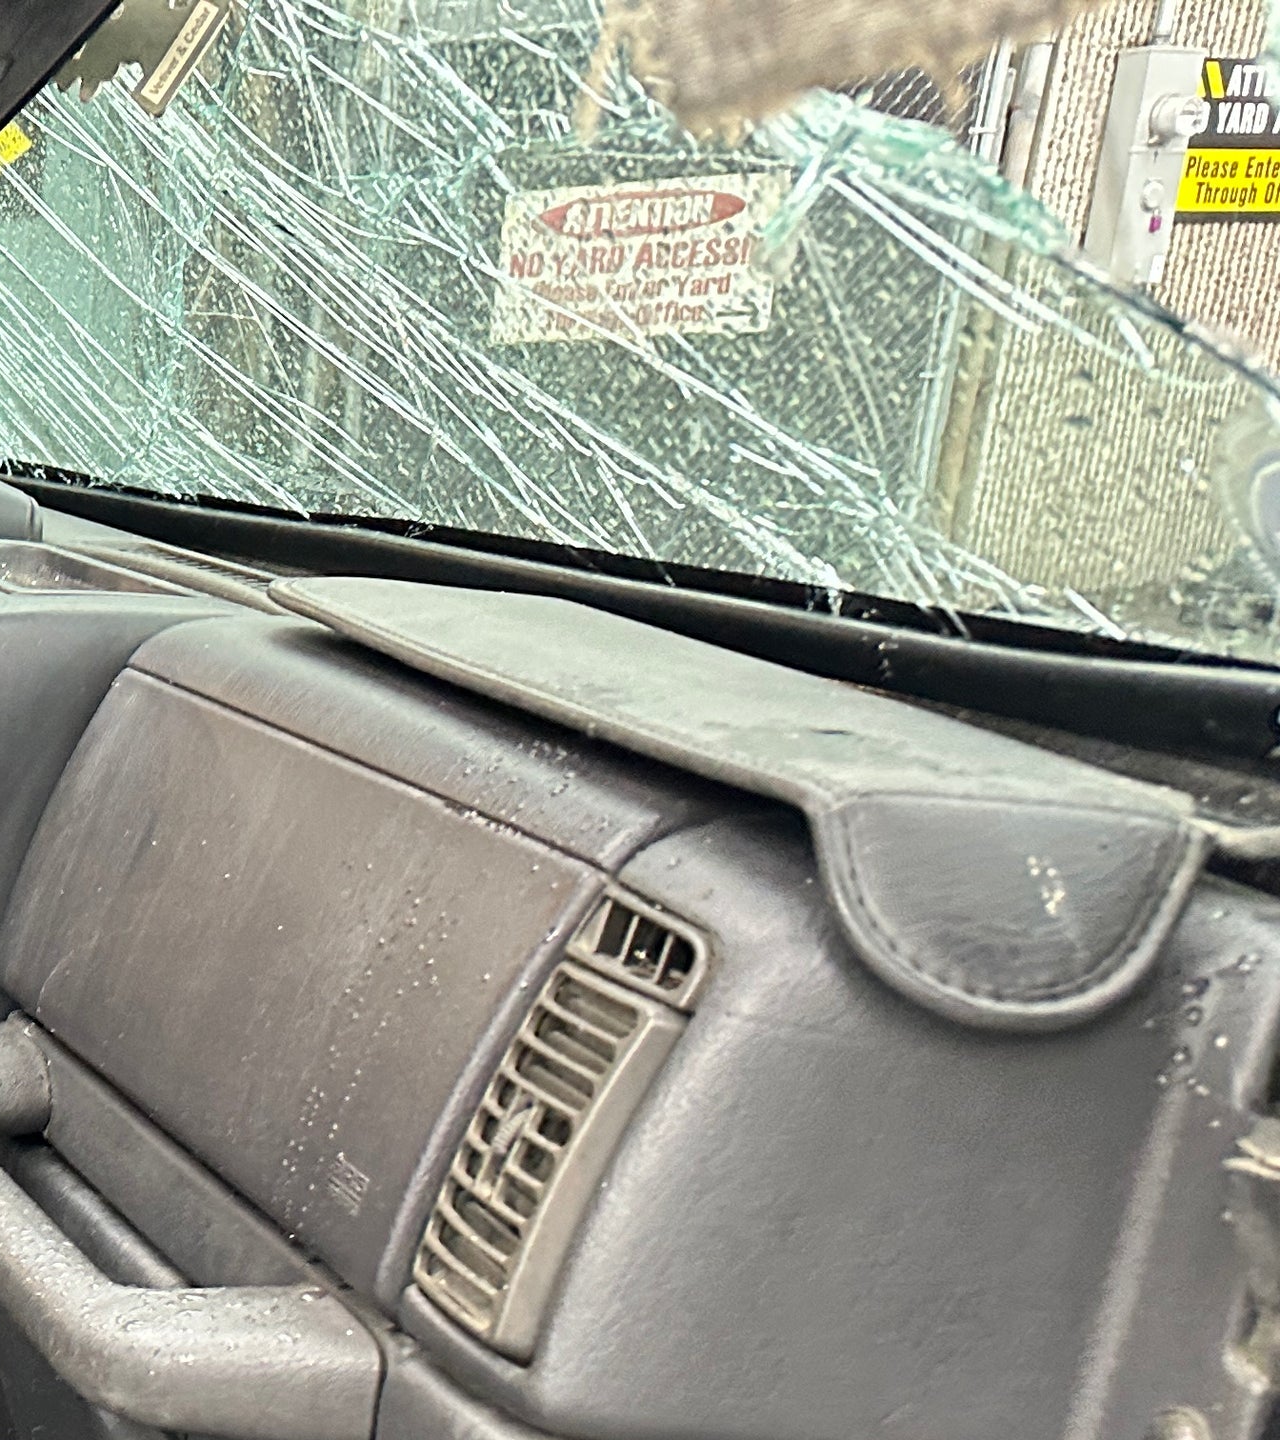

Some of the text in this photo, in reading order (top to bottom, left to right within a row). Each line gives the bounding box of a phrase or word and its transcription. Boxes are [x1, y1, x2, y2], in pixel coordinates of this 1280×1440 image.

[184, 7, 211, 44] Cedar
[1217, 102, 1270, 134] YARD
[1185, 155, 1239, 179] Please
[1195, 181, 1258, 208] Through
[508, 250, 546, 280] NO
[550, 244, 625, 277] YARD
[671, 272, 731, 298] Yard
